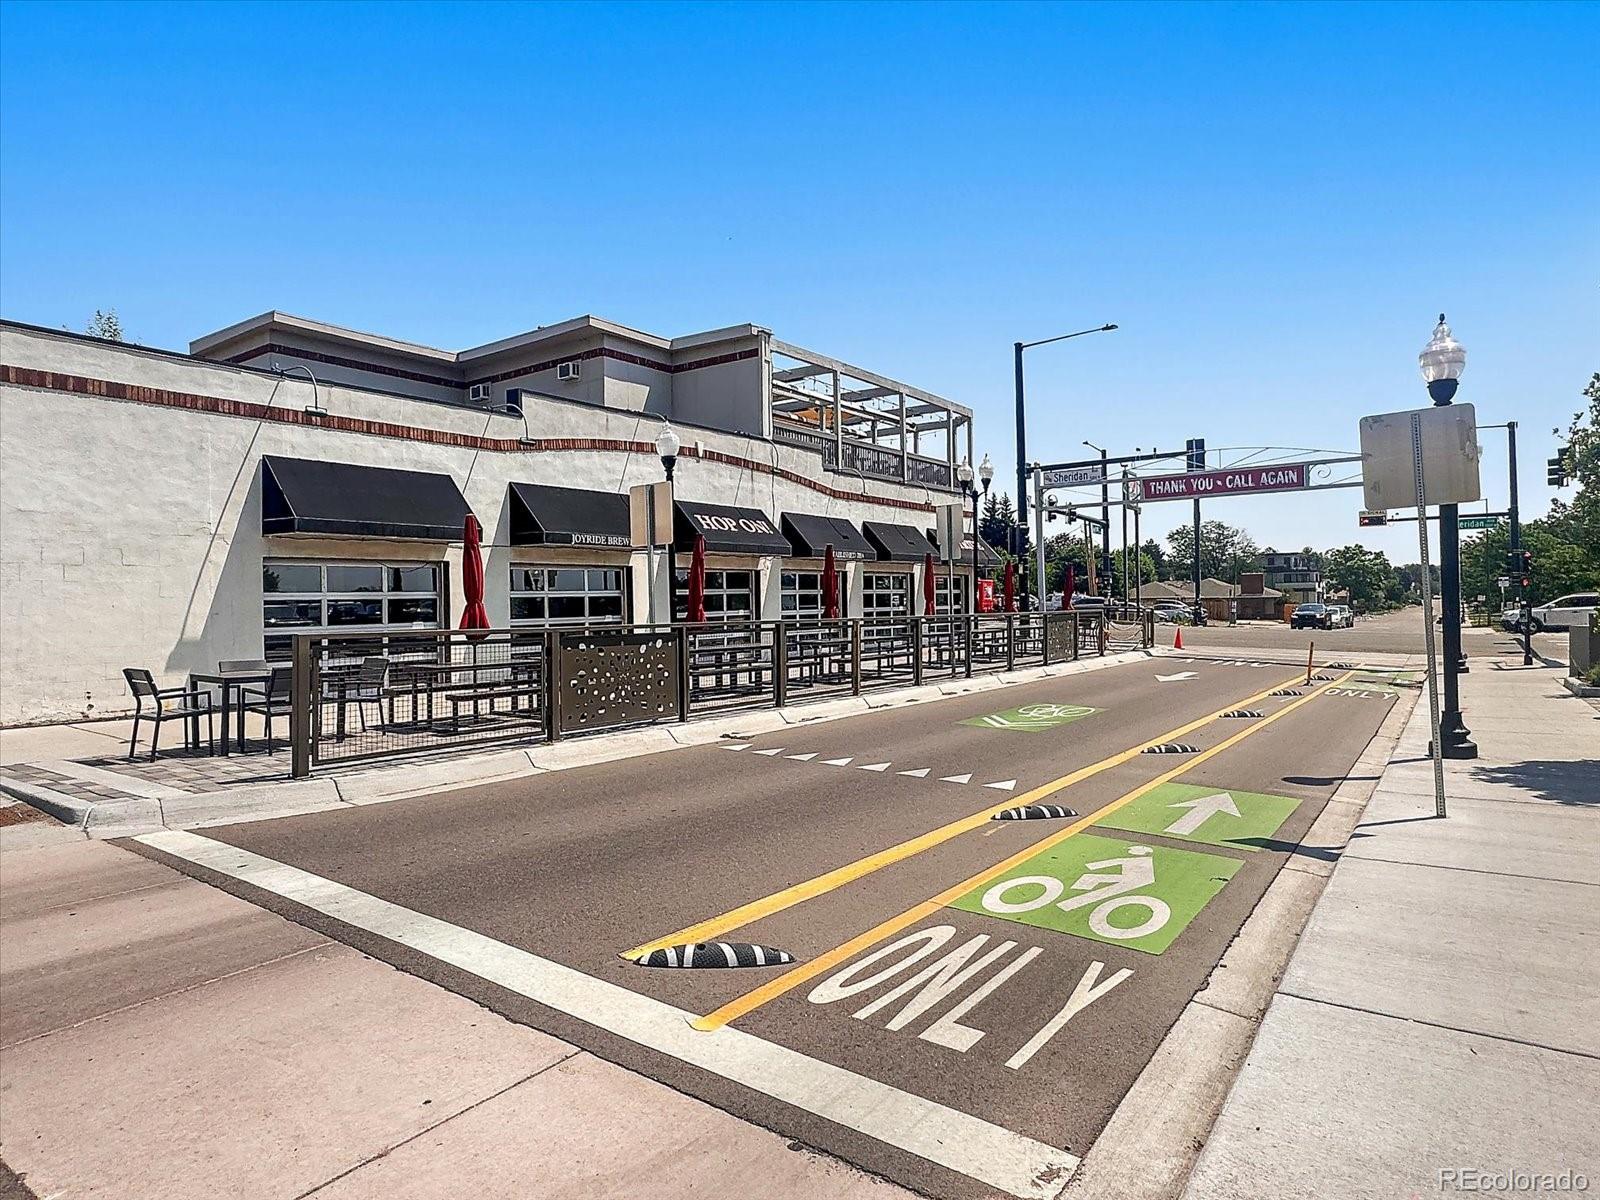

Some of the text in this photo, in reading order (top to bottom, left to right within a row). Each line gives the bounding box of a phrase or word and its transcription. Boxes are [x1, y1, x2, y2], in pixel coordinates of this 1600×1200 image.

[1053, 471, 1089, 483] Sheridan
[1149, 469, 1299, 495] THANK YOU CALL AGAIN
[693, 514, 775, 535] HOP ON!
[1459, 519, 1485, 529] eridan
[571, 533, 631, 546] JOYRIDE BREW
[1324, 687, 1396, 700] ONLY
[806, 925, 1135, 1071] ONLY
